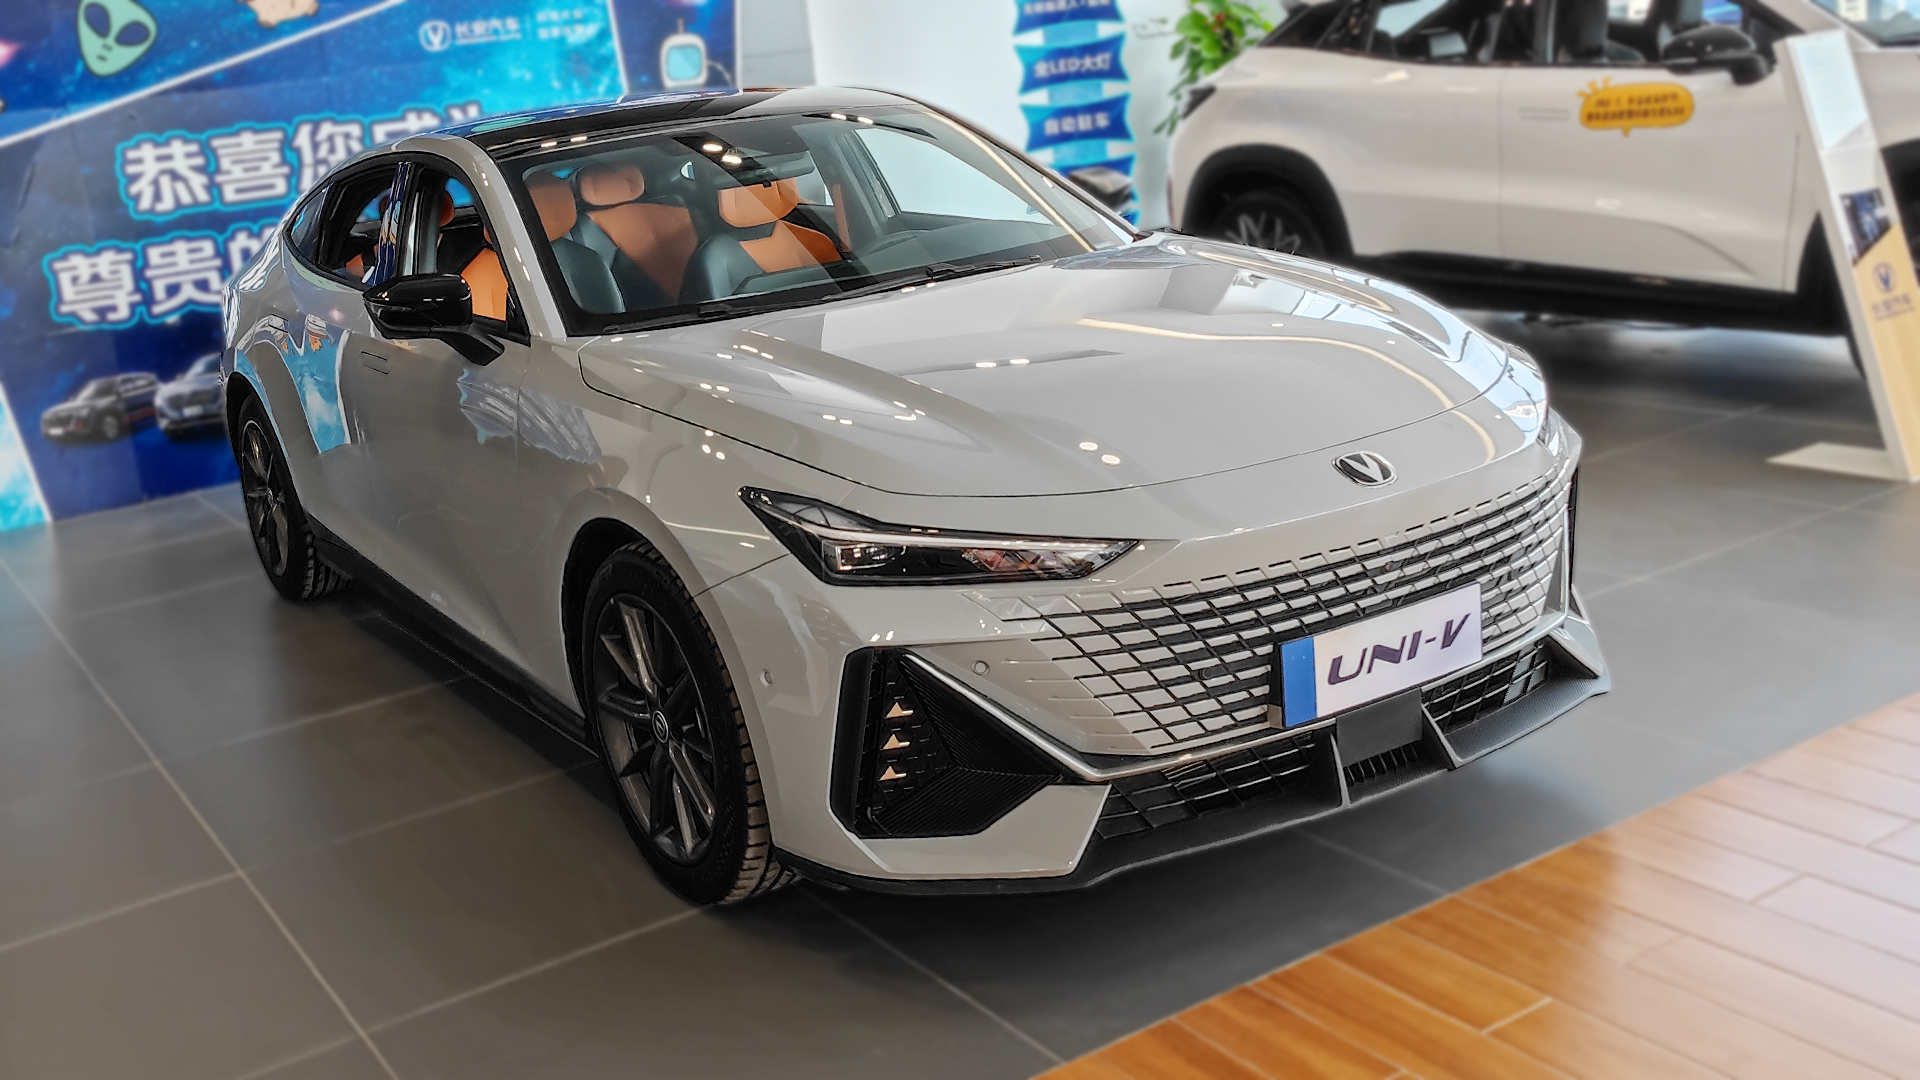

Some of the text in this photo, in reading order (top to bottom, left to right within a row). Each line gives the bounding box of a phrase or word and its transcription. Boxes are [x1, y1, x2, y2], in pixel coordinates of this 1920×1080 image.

[1033, 53, 1112, 78] 全LED大灯
[124, 103, 483, 213] 恭喜您
[1327, 612, 1472, 686] UNI-V
